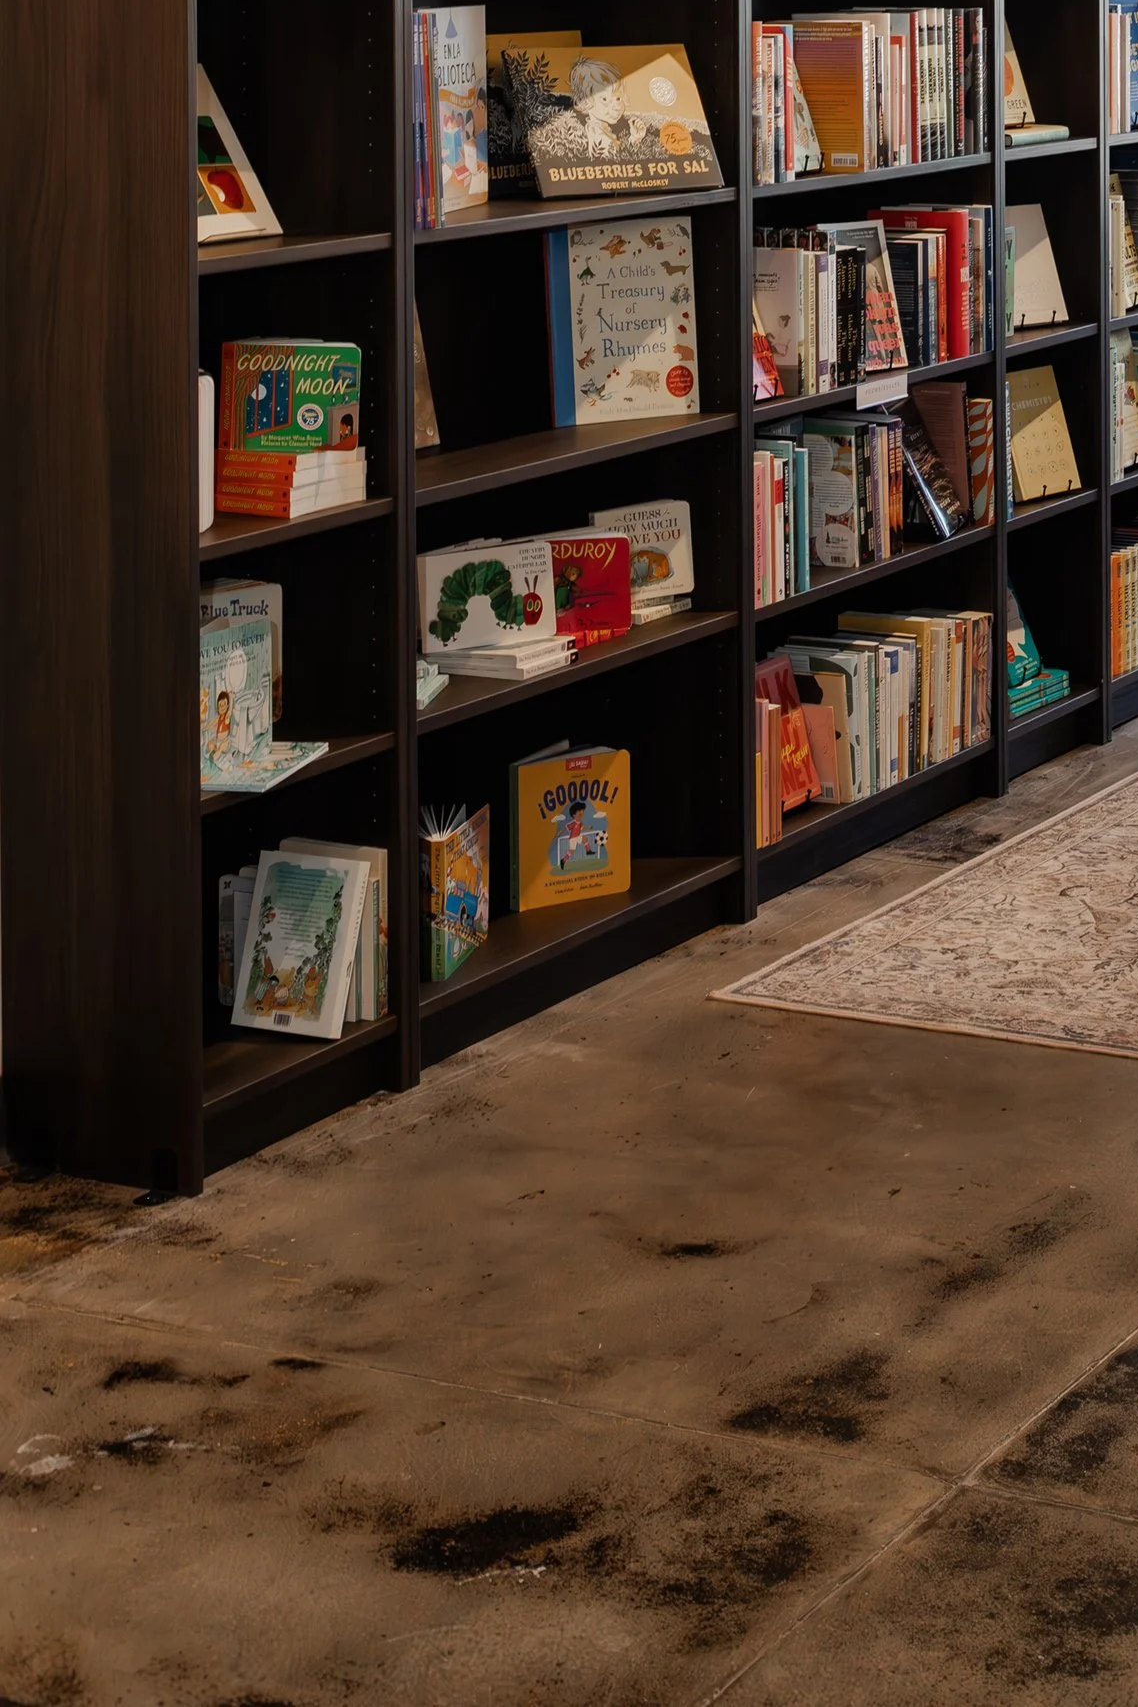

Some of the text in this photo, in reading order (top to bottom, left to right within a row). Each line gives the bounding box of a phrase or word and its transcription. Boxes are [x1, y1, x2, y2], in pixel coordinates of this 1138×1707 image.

[443, 44, 462, 59] EN LA
[1006, 98, 1028, 111] GREEN
[549, 159, 709, 182] BLUEBERRIES FOR SAL
[602, 181, 629, 189] ROBERT
[606, 265, 656, 279] A Child's
[597, 282, 665, 301] Treasury
[625, 302, 638, 314] of
[598, 312, 668, 334] Nursery
[602, 339, 667, 361] Rhymes
[868, 337, 902, 355] queer
[237, 354, 341, 372] GOODNIGHT
[295, 378, 350, 395] MOON
[1011, 396, 1052, 411] CHEMISTRY
[623, 509, 661, 523] GUESS
[641, 518, 678, 532] MUCH
[631, 529, 681, 545] OVE YOU
[521, 554, 546, 562] HUNGRY
[200, 598, 269, 618] Blue Truck
[538, 779, 619, 820] ¡GOOOOL!
